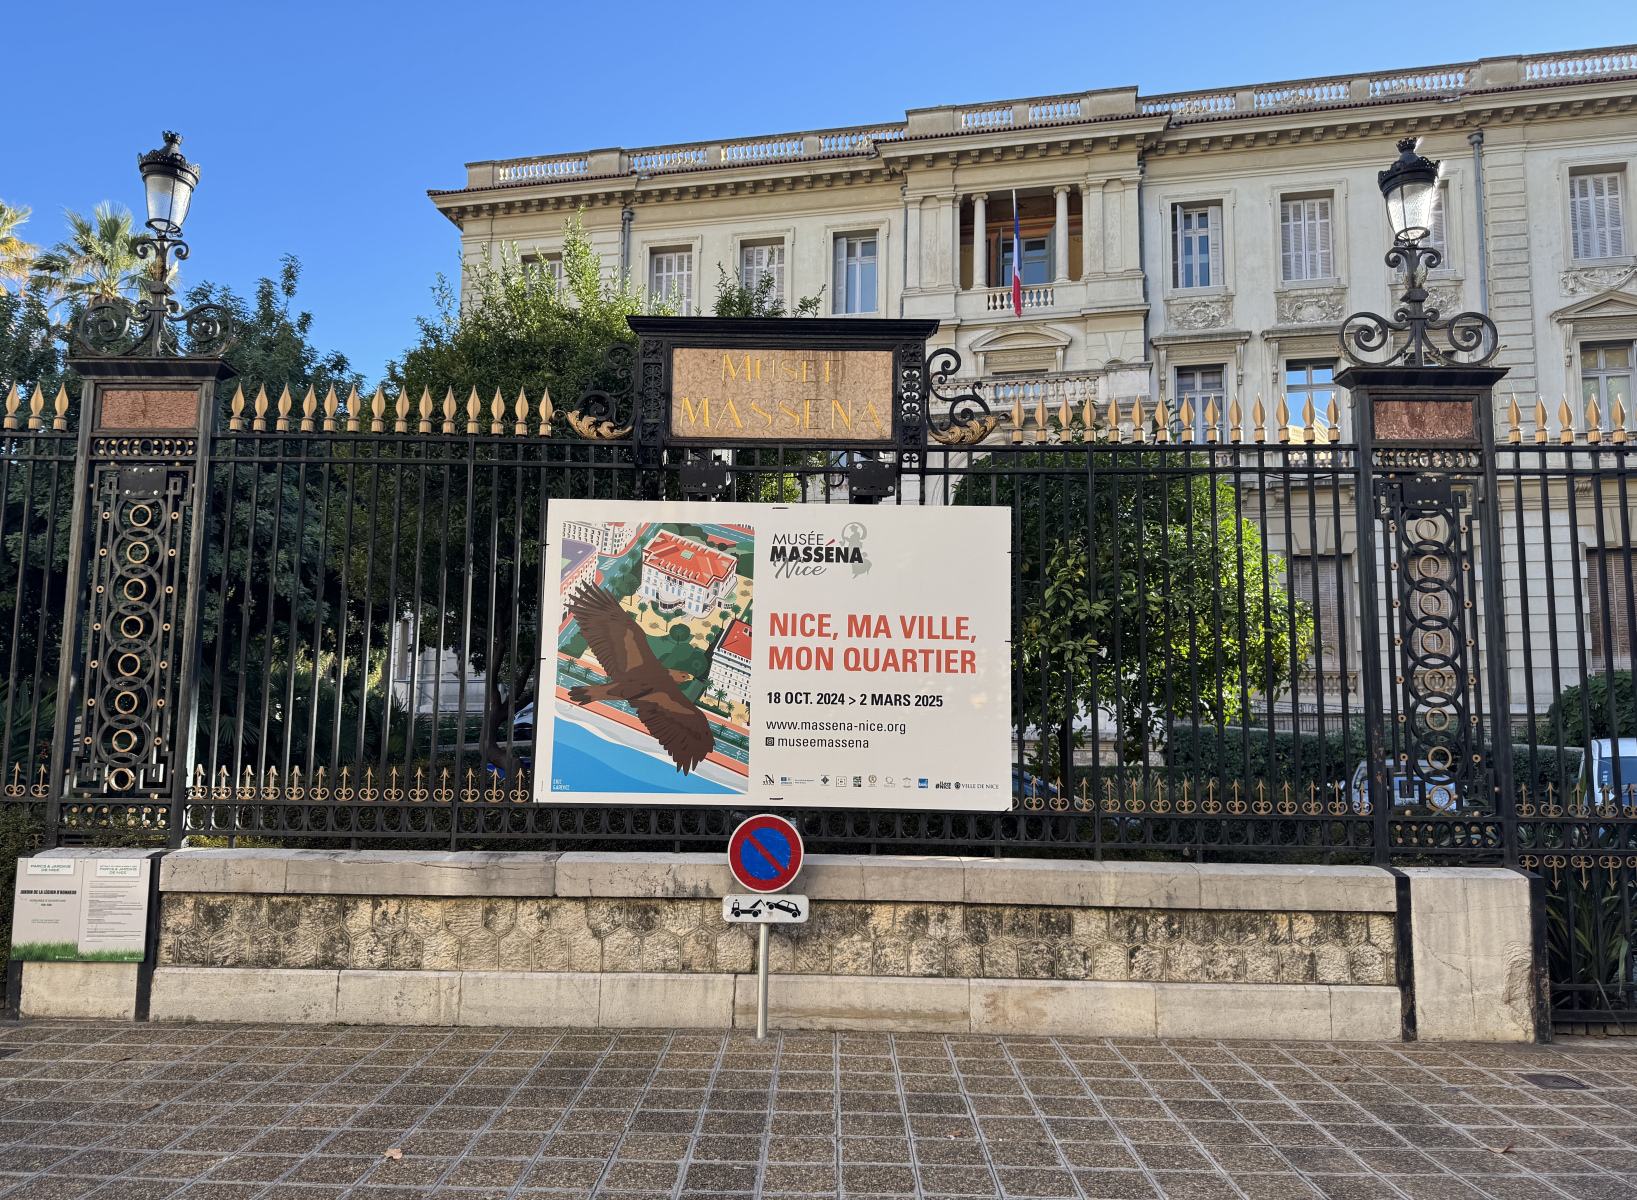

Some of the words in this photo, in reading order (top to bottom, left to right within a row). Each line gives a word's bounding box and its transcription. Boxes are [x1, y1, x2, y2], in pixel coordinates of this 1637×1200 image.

[680, 396, 883, 431] MASSENA
[772, 530, 824, 546] MUSÉE
[770, 538, 864, 564] MASSÉNA
[773, 556, 827, 579] Nice
[769, 612, 838, 641] NICE,
[847, 614, 892, 639] MA
[899, 615, 977, 643] VILLE,
[768, 645, 834, 671] MON
[843, 647, 976, 674] QUARTIER
[766, 691, 781, 704] 18
[784, 691, 813, 705] OCT.
[816, 692, 845, 705] 2024
[859, 693, 868, 706] 2
[870, 693, 911, 707] MARS
[914, 694, 943, 707] 2025
[766, 719, 906, 734] www.massena-nice.org
[777, 737, 869, 748] museemassena
